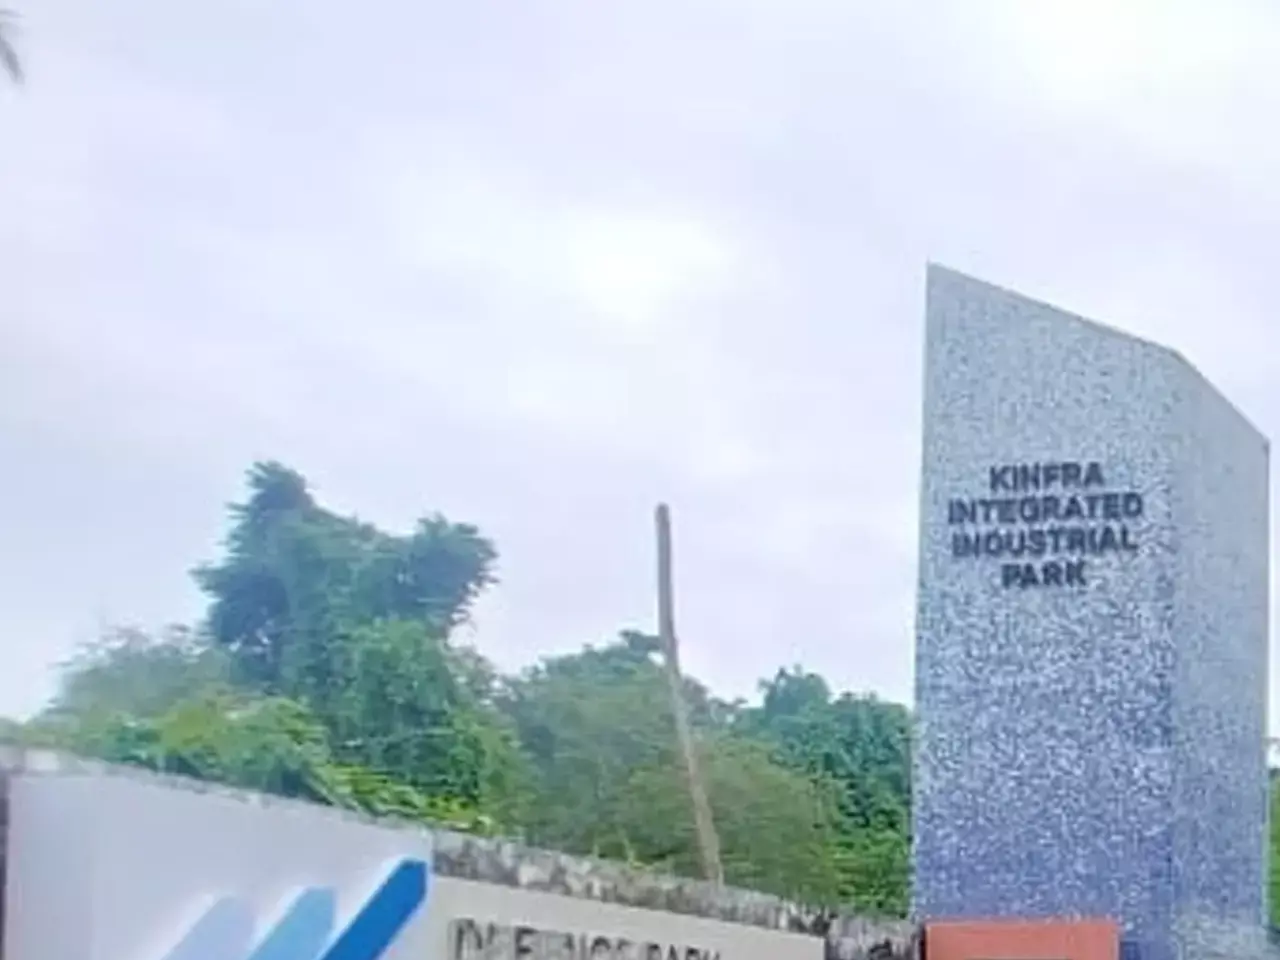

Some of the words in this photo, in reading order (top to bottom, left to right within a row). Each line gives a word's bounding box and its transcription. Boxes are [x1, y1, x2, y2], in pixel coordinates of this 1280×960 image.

[989, 462, 1104, 492] KINFRA
[948, 493, 1143, 525] INTEGRATED
[951, 525, 1138, 557] INDUSTRIAL
[1001, 560, 1087, 589] PARK
